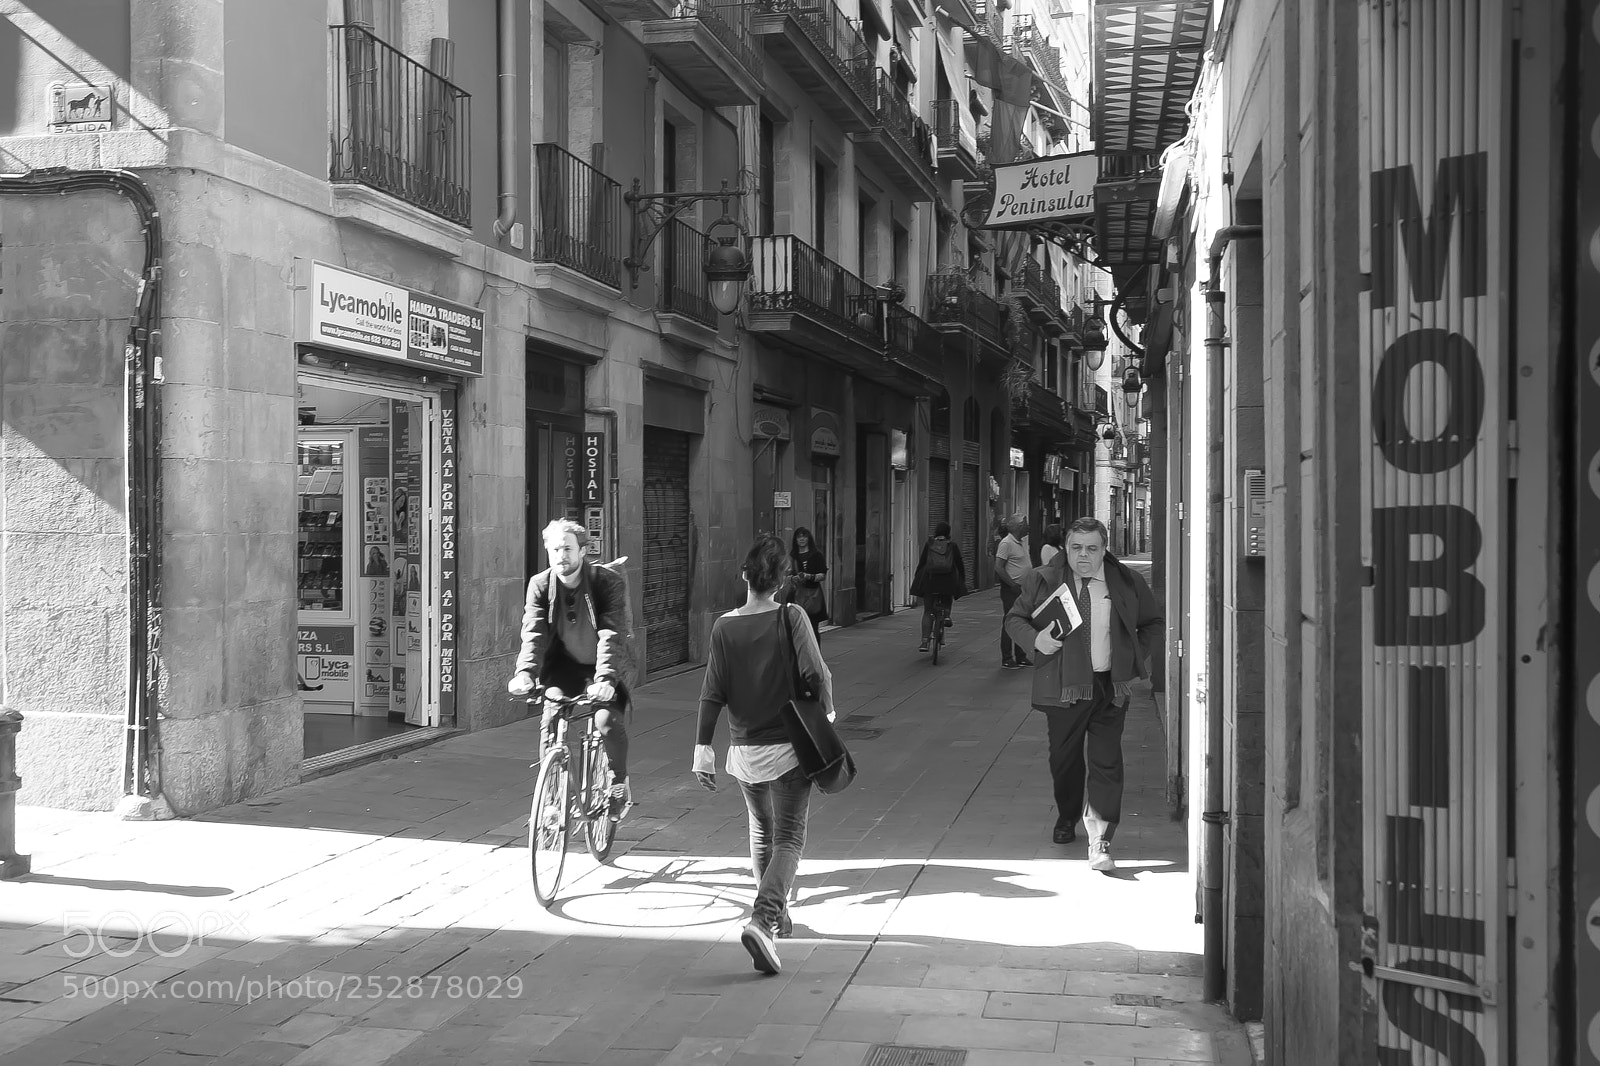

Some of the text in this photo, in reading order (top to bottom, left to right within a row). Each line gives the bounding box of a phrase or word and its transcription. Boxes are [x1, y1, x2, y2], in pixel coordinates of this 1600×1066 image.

[54, 123, 108, 134] SALIDA
[1020, 164, 1070, 190] Hotel
[996, 190, 1094, 218] Peninsular
[320, 282, 402, 324] Lycamobile
[409, 300, 437, 318] HAMZA
[438, 307, 471, 328] TRADERS
[586, 436, 598, 500] HOSTAL
[440, 409, 454, 692] VENTA AL POR MAYOR Y AL POR MENOR
[321, 658, 349, 671] Lyca
[321, 669, 349, 678] mobile
